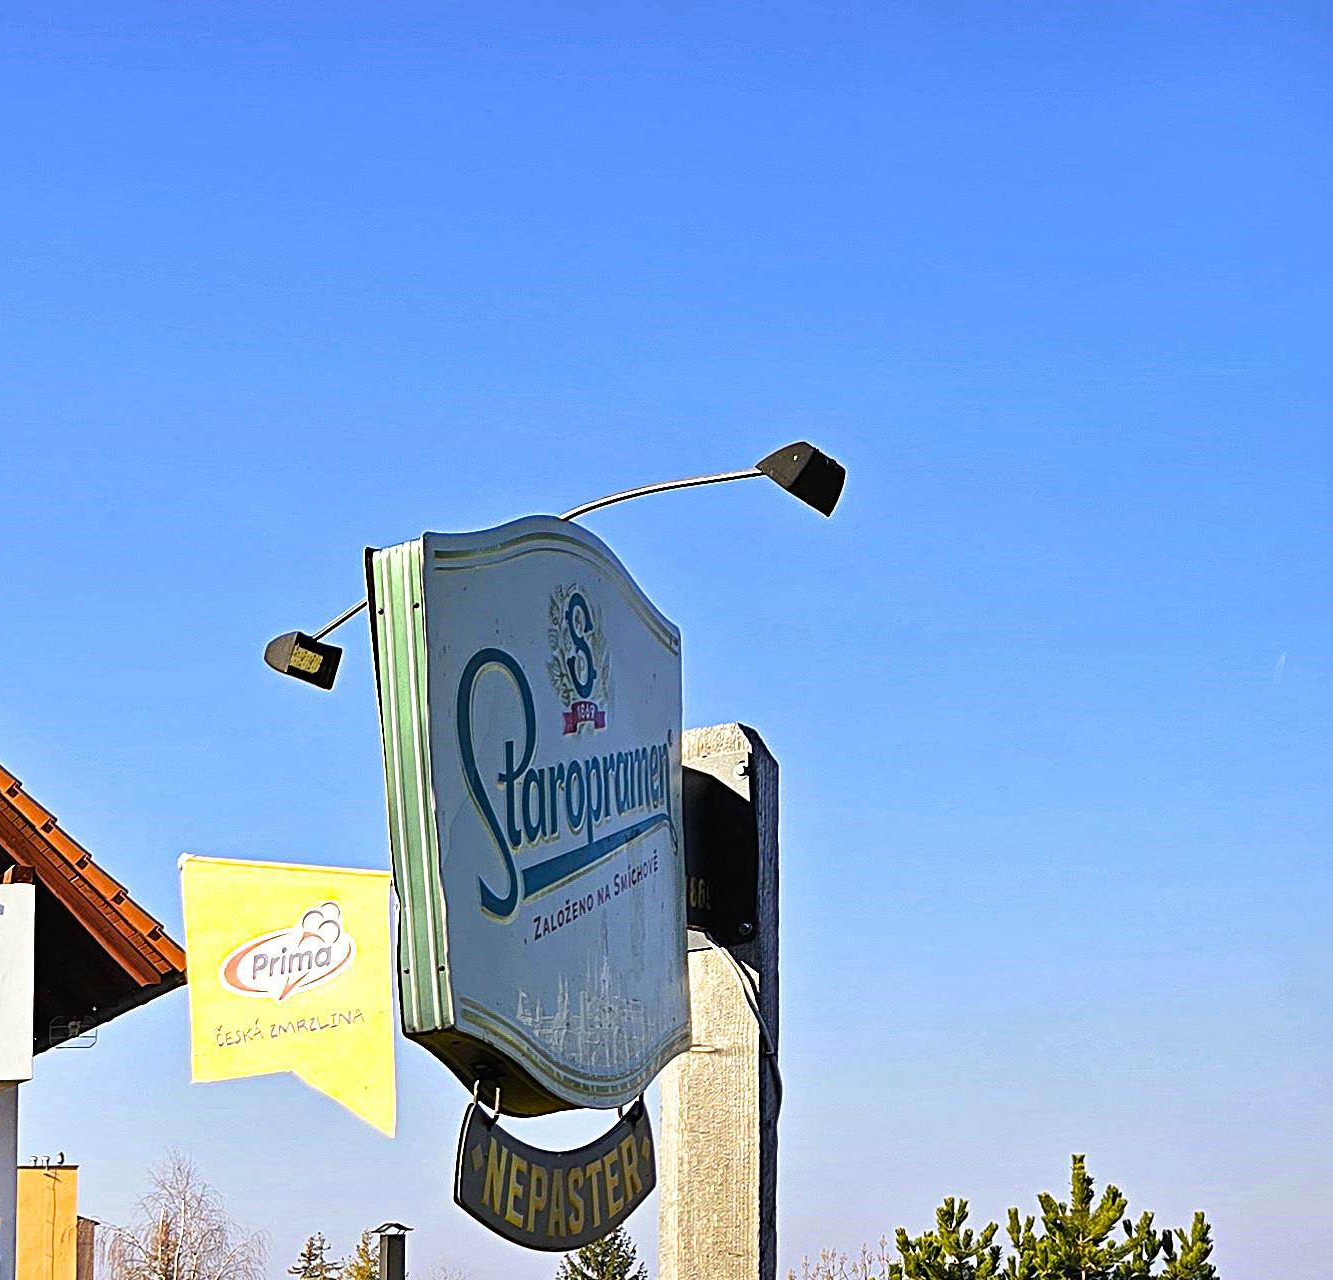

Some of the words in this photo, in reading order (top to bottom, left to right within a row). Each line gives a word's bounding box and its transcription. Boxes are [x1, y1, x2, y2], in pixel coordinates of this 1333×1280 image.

[565, 593, 597, 698] S
[576, 703, 596, 719] 1869
[457, 648, 677, 916] Staropramen
[533, 893, 594, 940] ZALOŽENO
[252, 946, 333, 980] Prima
[216, 1018, 264, 1047] ČESKÁ
[270, 1008, 365, 1039] ZMRZLINA
[484, 1134, 643, 1237] NEPASTER
